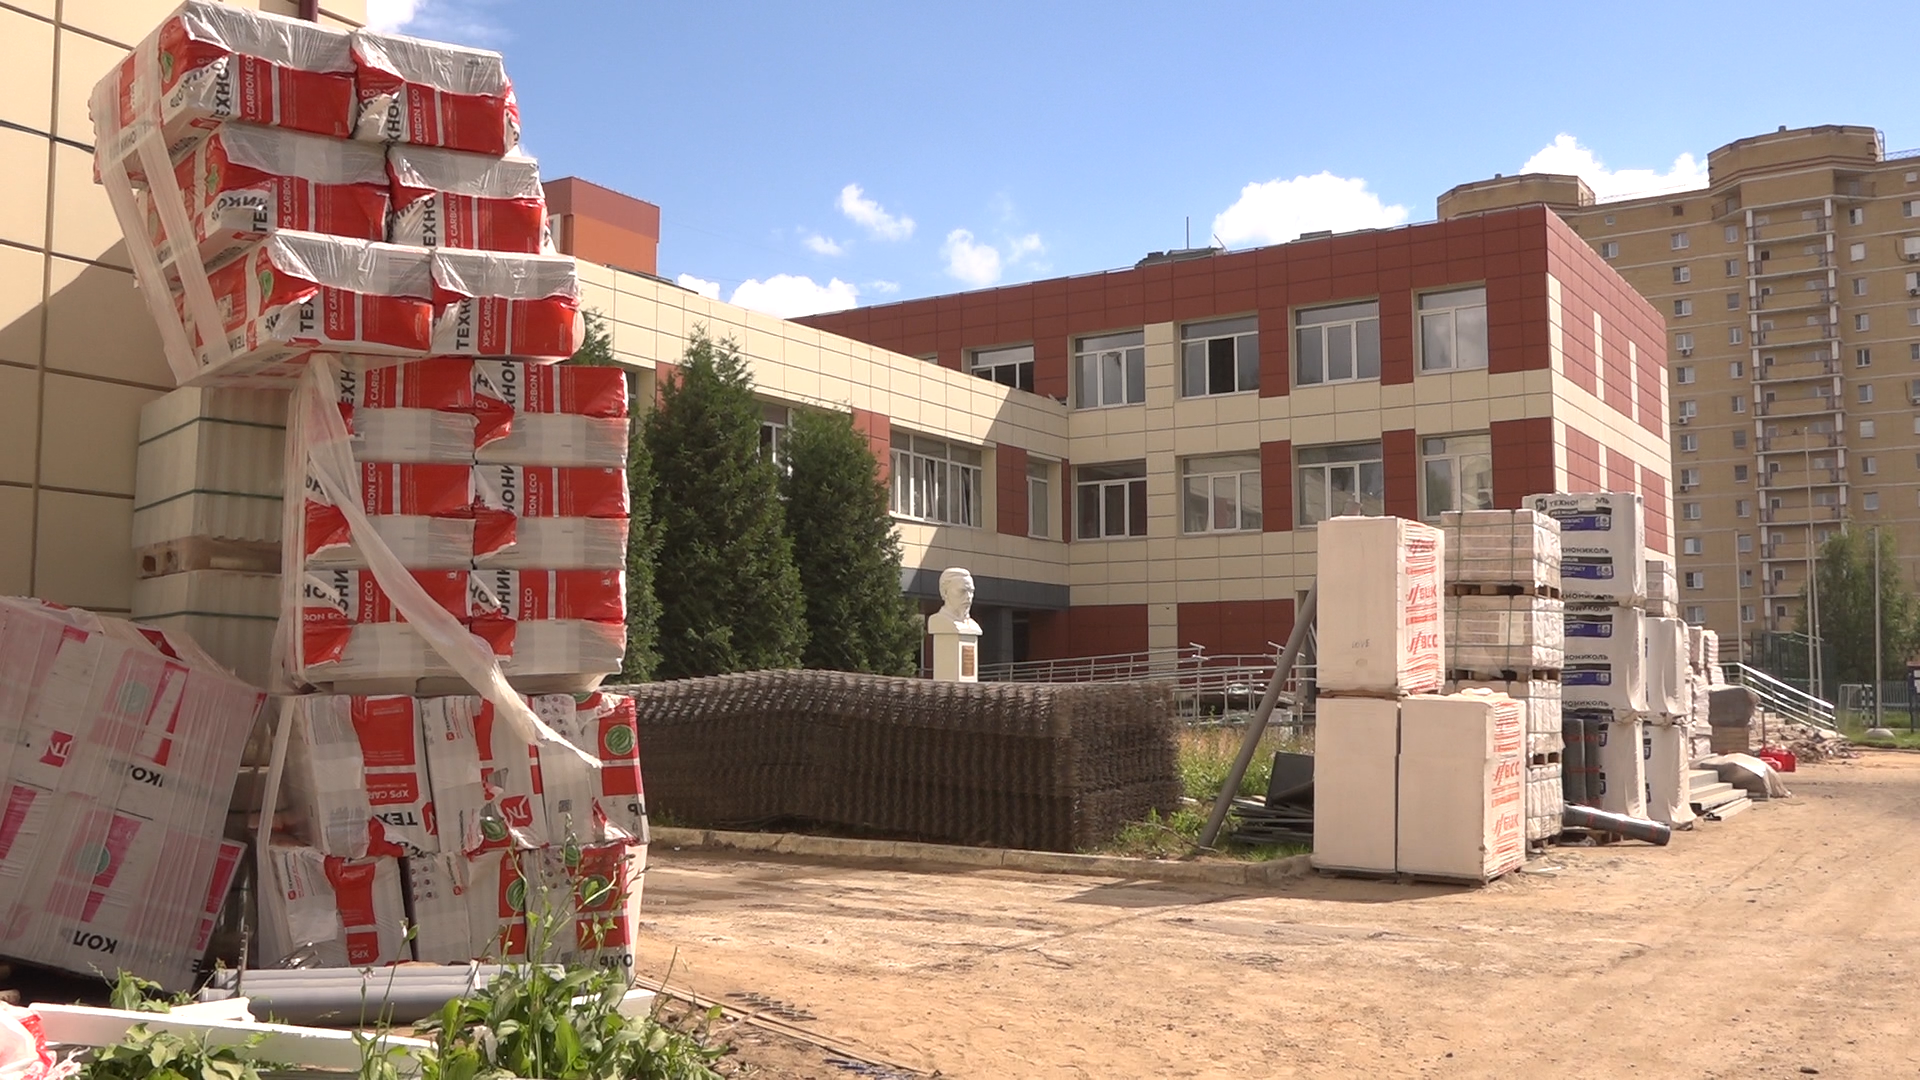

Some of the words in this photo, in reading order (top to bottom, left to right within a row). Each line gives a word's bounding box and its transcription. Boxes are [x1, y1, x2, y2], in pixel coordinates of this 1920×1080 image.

[367, 462, 376, 483] ECO
[529, 473, 537, 494] ECO
[364, 581, 373, 602] ECO
[524, 588, 532, 607] ECO
